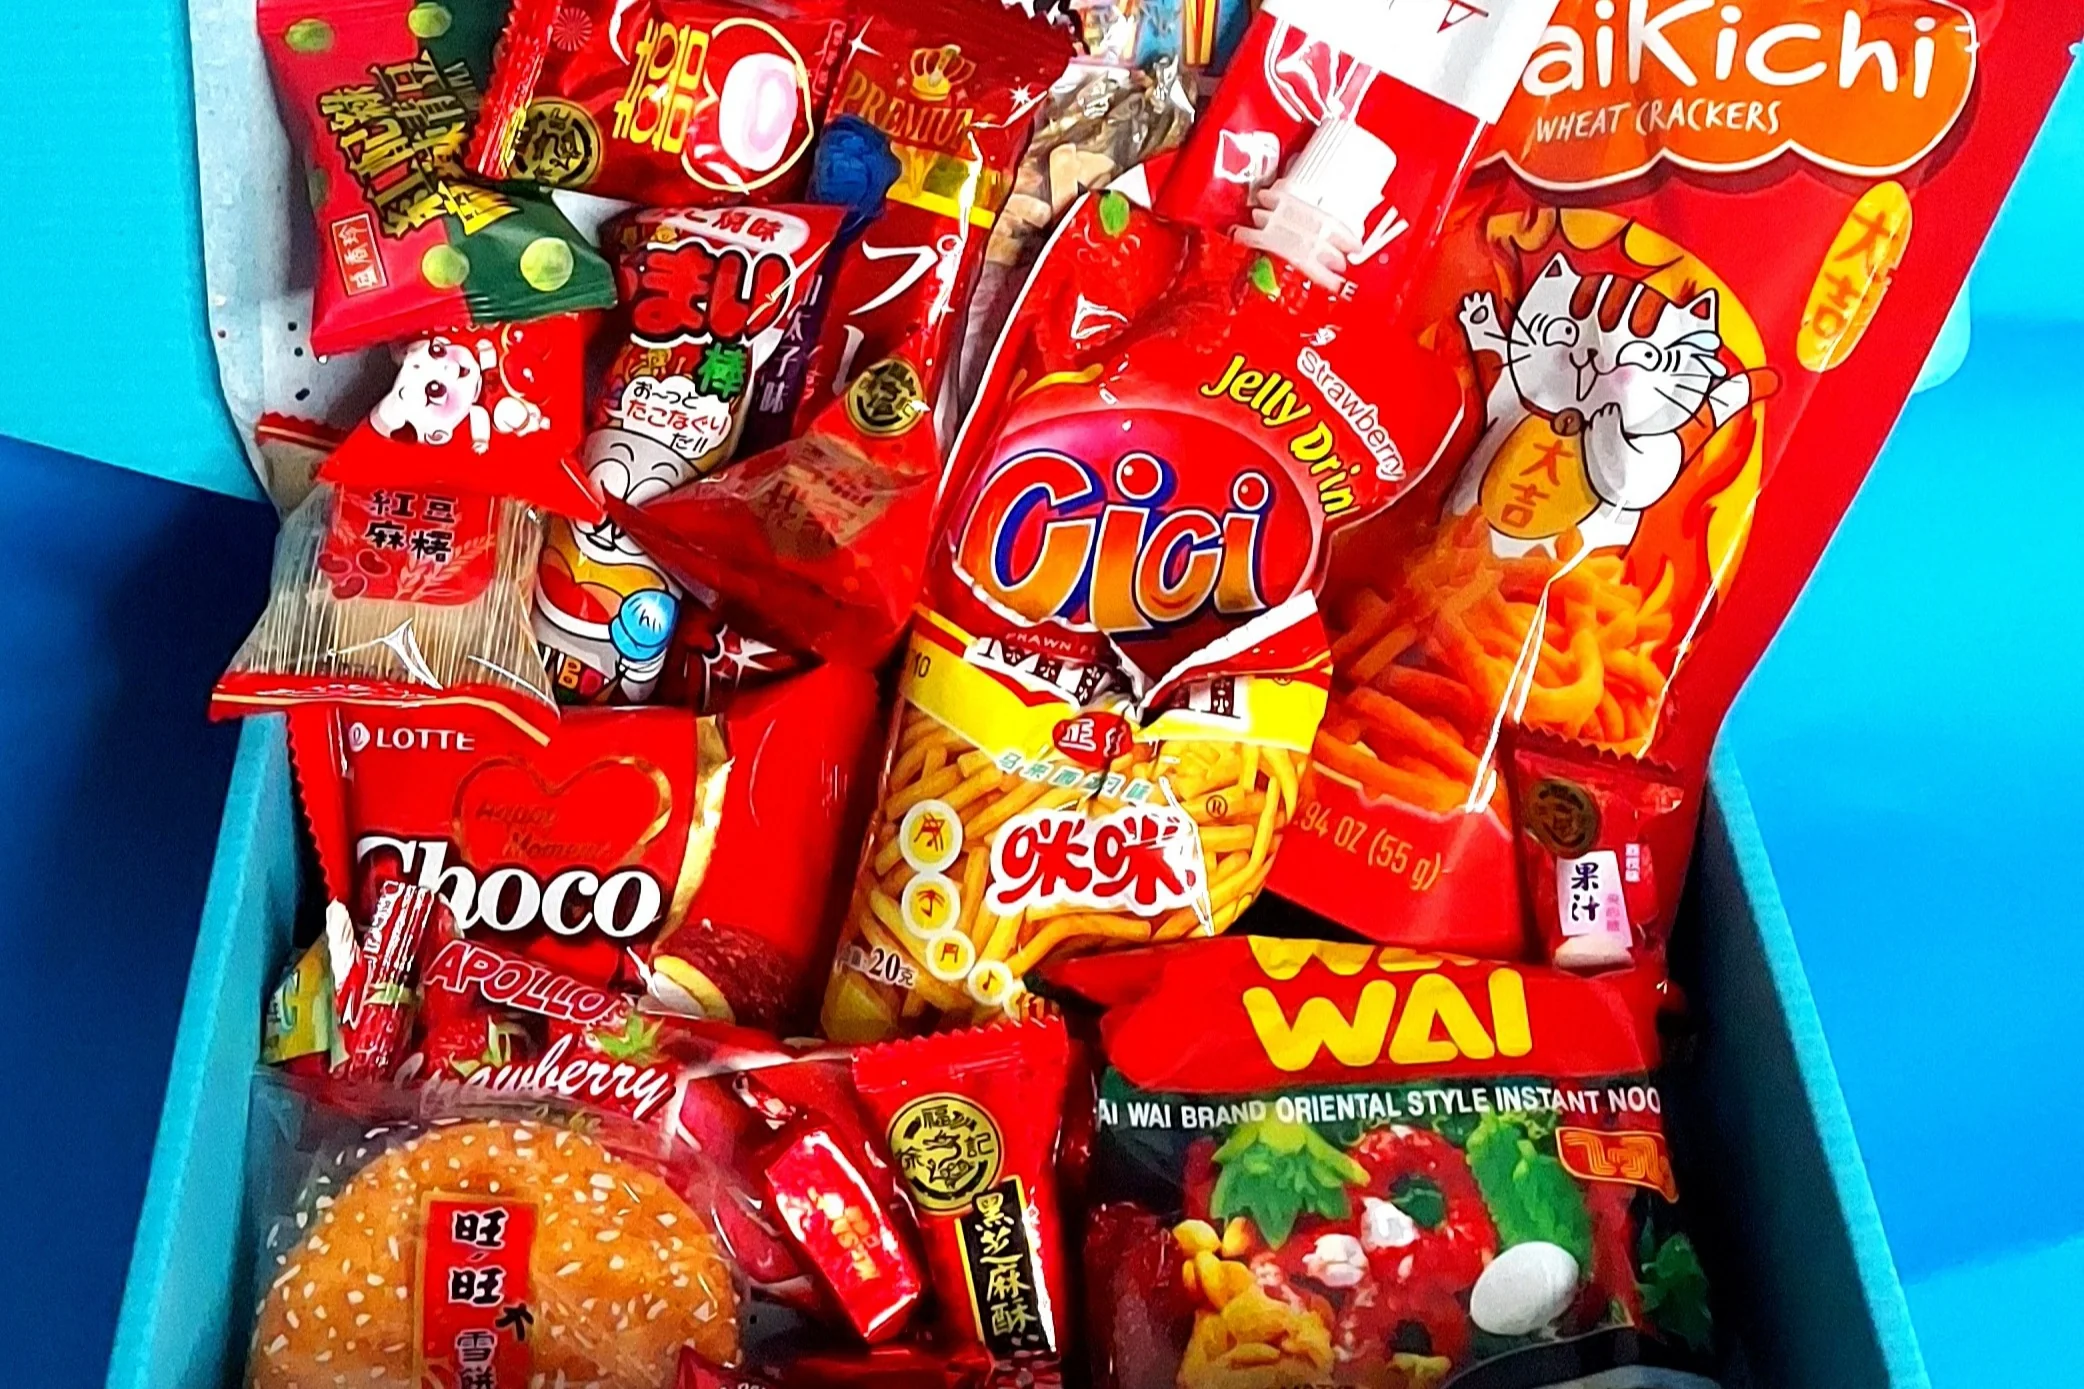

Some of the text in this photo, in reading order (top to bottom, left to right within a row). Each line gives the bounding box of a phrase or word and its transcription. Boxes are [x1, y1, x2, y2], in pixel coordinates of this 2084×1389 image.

[1521, 0, 1937, 99] aiKichi
[1536, 97, 1782, 142] WHEAT CRACKERS
[1201, 355, 1361, 522] Jelly Drin
[1299, 347, 1405, 481] Strawberry
[370, 489, 457, 523] 紅豆
[1500, 439, 1574, 529] 大吉
[958, 452, 1271, 633] Cici
[376, 728, 476, 750] LOTTE
[356, 836, 662, 938] Choco
[997, 814, 1196, 905] 咪咪
[1293, 799, 1441, 891] .94 OZ (55 g)
[1571, 862, 1600, 922] 果汁
[424, 939, 608, 1025] APOLLO
[1242, 966, 1533, 1072] WAI
[1098, 1098, 1118, 1126] AI
[1127, 1102, 1171, 1128] WAI
[1181, 1099, 1266, 1129] BRAND
[1275, 1091, 1402, 1124] ORIENTAL
[1408, 1088, 1491, 1116] STYLE
[1495, 1085, 1600, 1116] INSTANT
[449, 1206, 509, 1306] 旺旺
[974, 1192, 1039, 1337] 黑芝麻酥
